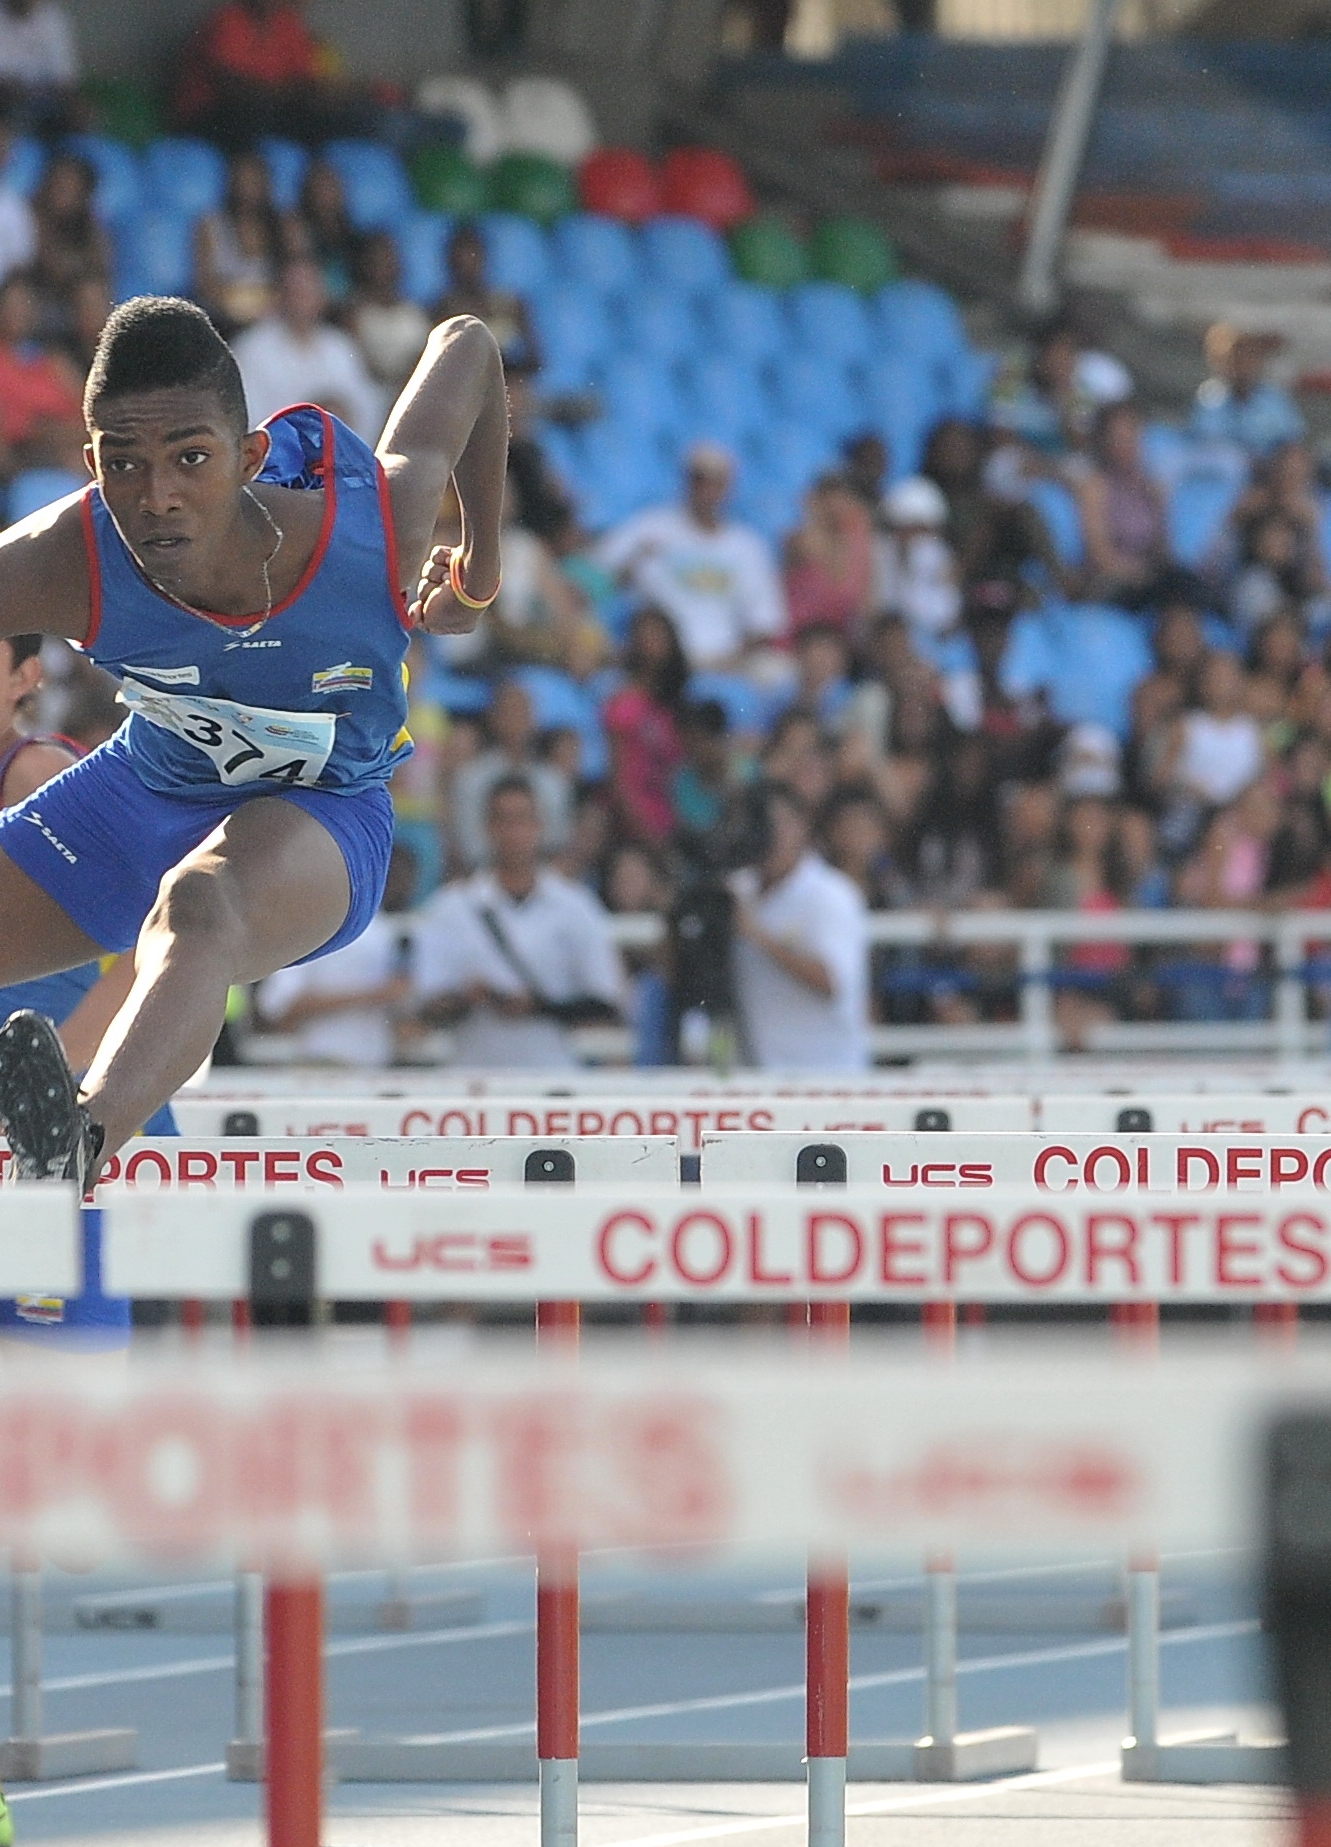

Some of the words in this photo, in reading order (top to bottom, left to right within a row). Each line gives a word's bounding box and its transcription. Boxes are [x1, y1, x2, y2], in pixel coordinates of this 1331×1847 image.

[241, 640, 282, 648] SAETA
[183, 713, 309, 784] 374
[594, 1207, 1331, 1289] COLDEPORTES
